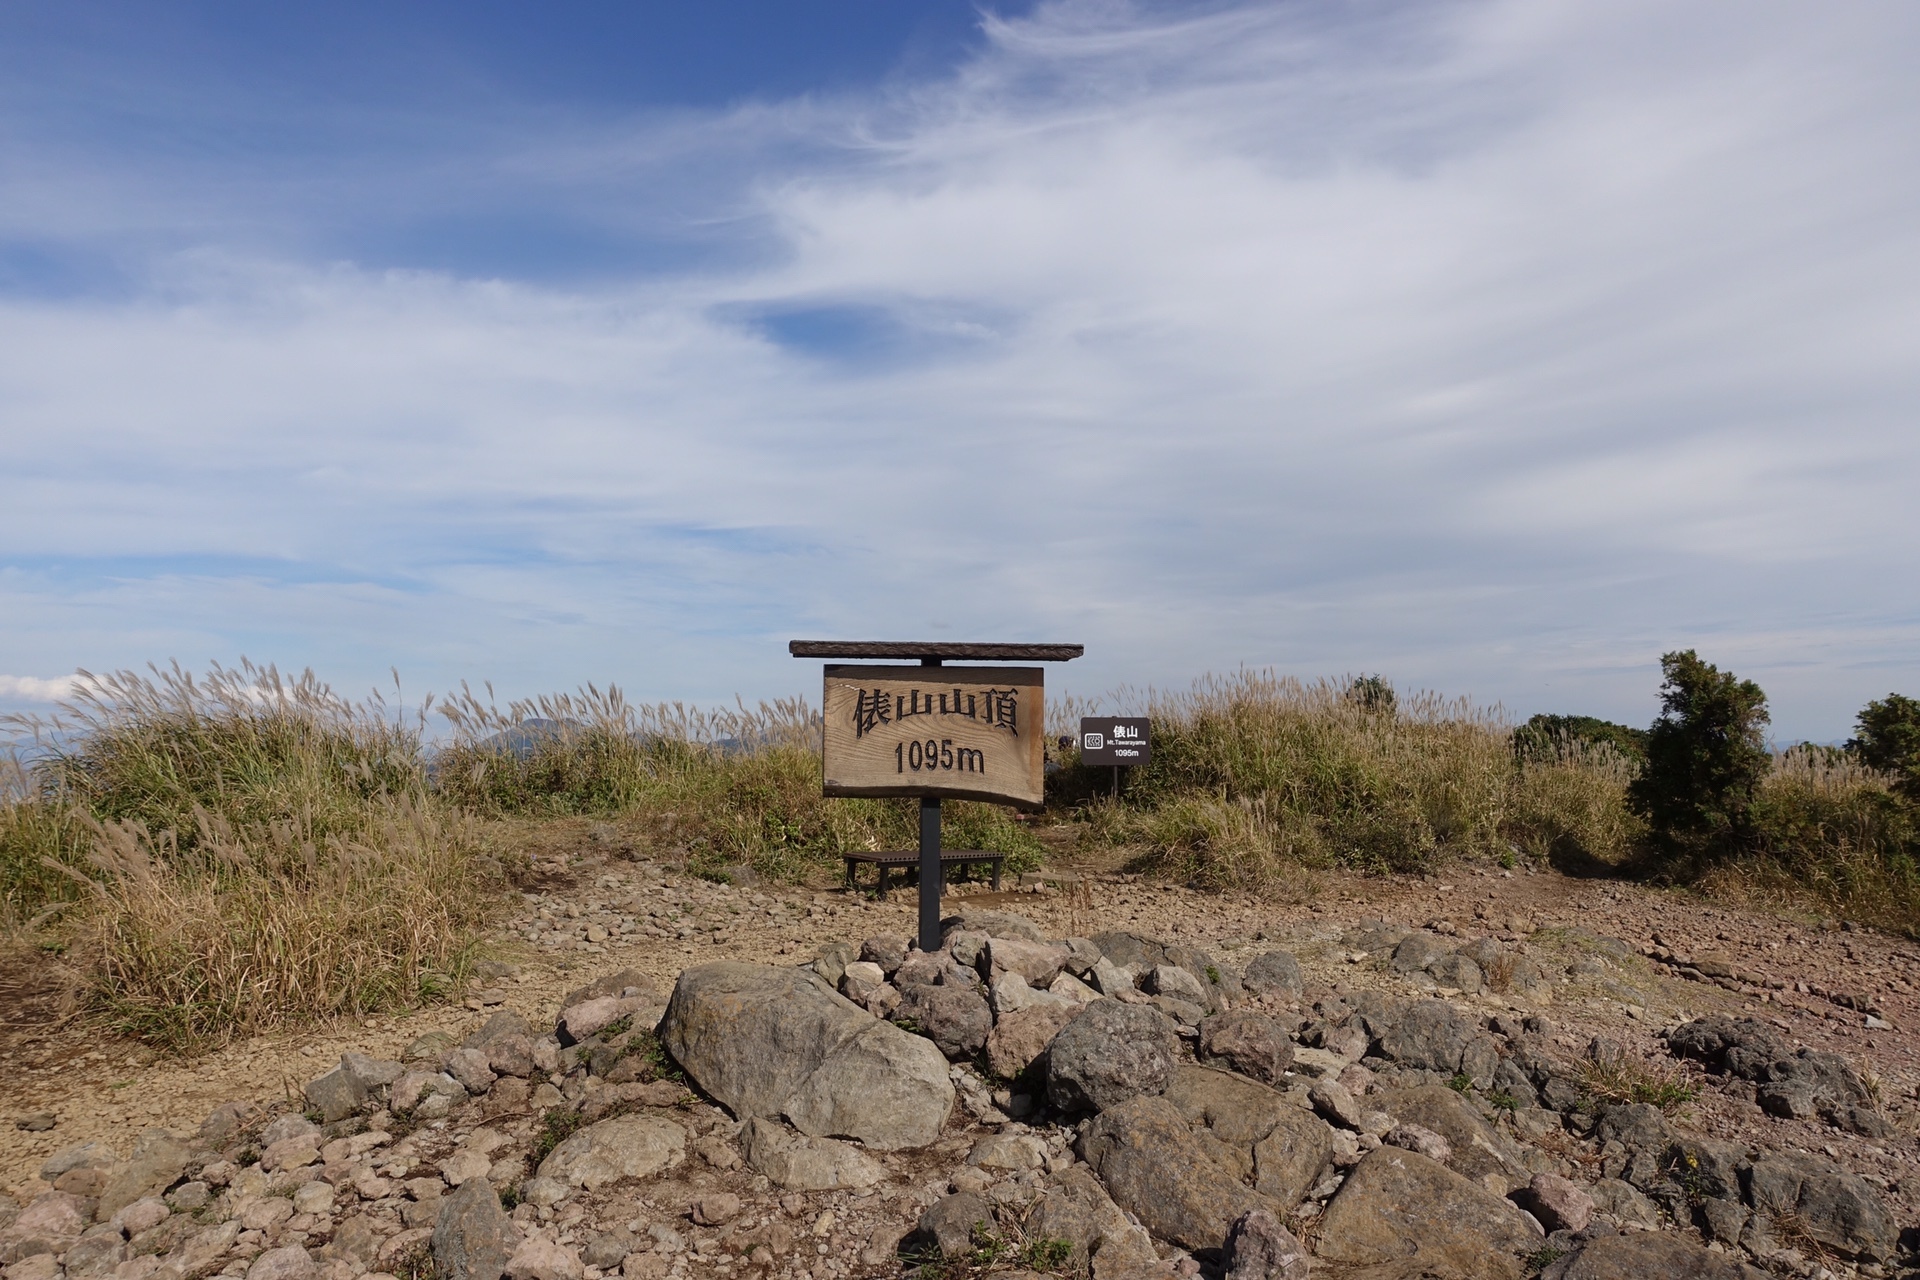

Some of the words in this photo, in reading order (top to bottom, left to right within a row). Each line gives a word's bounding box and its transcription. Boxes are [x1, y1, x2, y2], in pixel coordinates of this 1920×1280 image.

[853, 688, 1018, 739] 俵山山頂
[1113, 725, 1138, 738] 俵山
[895, 739, 984, 775] 1095m
